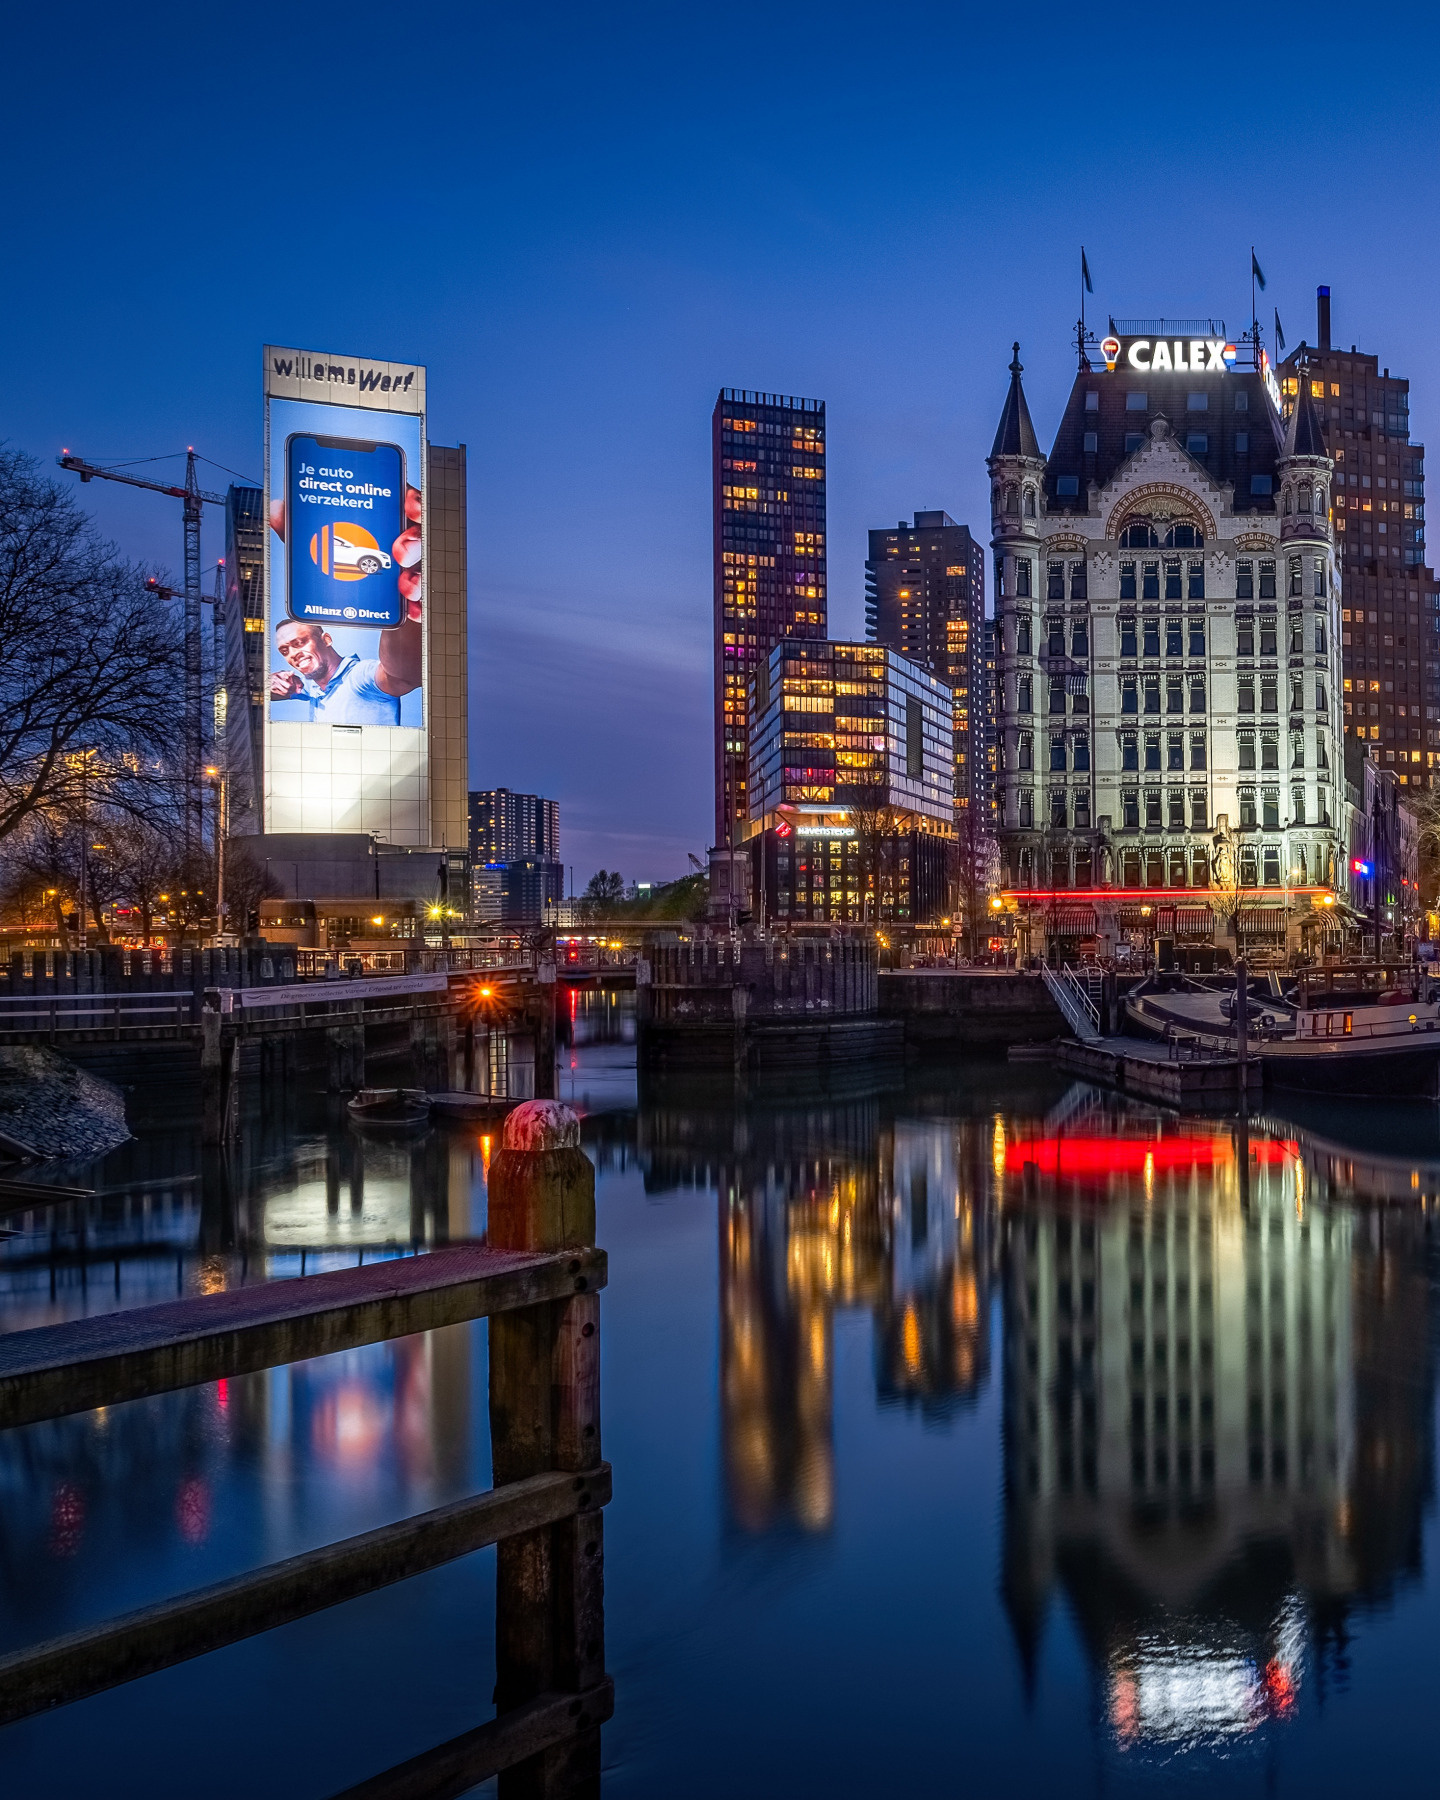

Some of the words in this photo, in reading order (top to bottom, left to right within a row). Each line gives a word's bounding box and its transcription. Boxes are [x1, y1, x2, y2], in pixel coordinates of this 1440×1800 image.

[1128, 340, 1227, 370] CALEX
[298, 462, 315, 475] Je
[318, 467, 354, 479] auto
[298, 476, 343, 493] direct
[345, 483, 392, 498] online
[298, 493, 374, 510] verzekerd
[303, 604, 342, 616] Allianz
[358, 608, 391, 620] Direct
